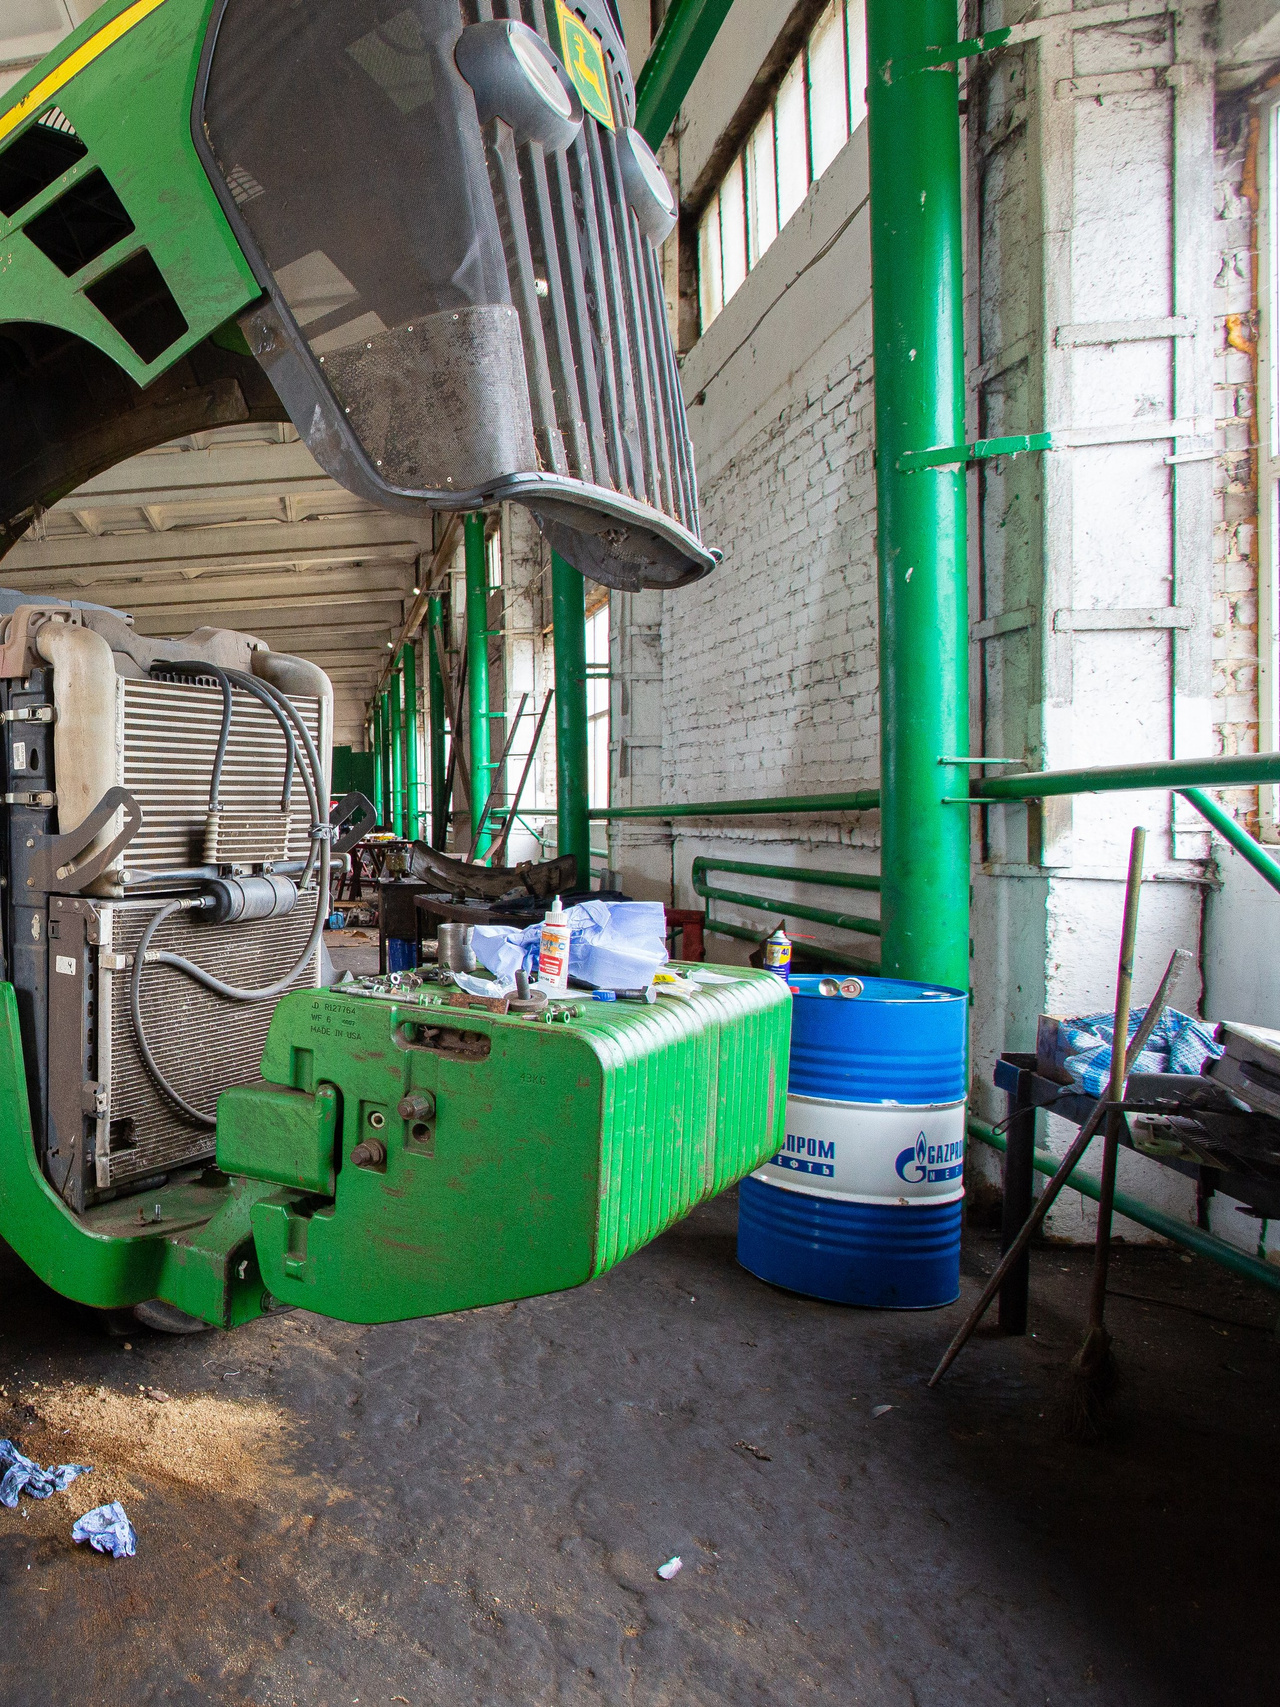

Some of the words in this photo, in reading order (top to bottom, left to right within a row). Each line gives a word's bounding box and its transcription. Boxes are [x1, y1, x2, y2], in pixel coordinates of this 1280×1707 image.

[324, 1003, 356, 1015] R127764
[310, 1013, 322, 1022] WF
[310, 1025, 331, 1036] MADE
[334, 1029, 343, 1037] IN
[346, 1031, 361, 1040] USA
[777, 1156, 830, 1175] ЕФТЬ
[929, 1166, 959, 1181] NEF
